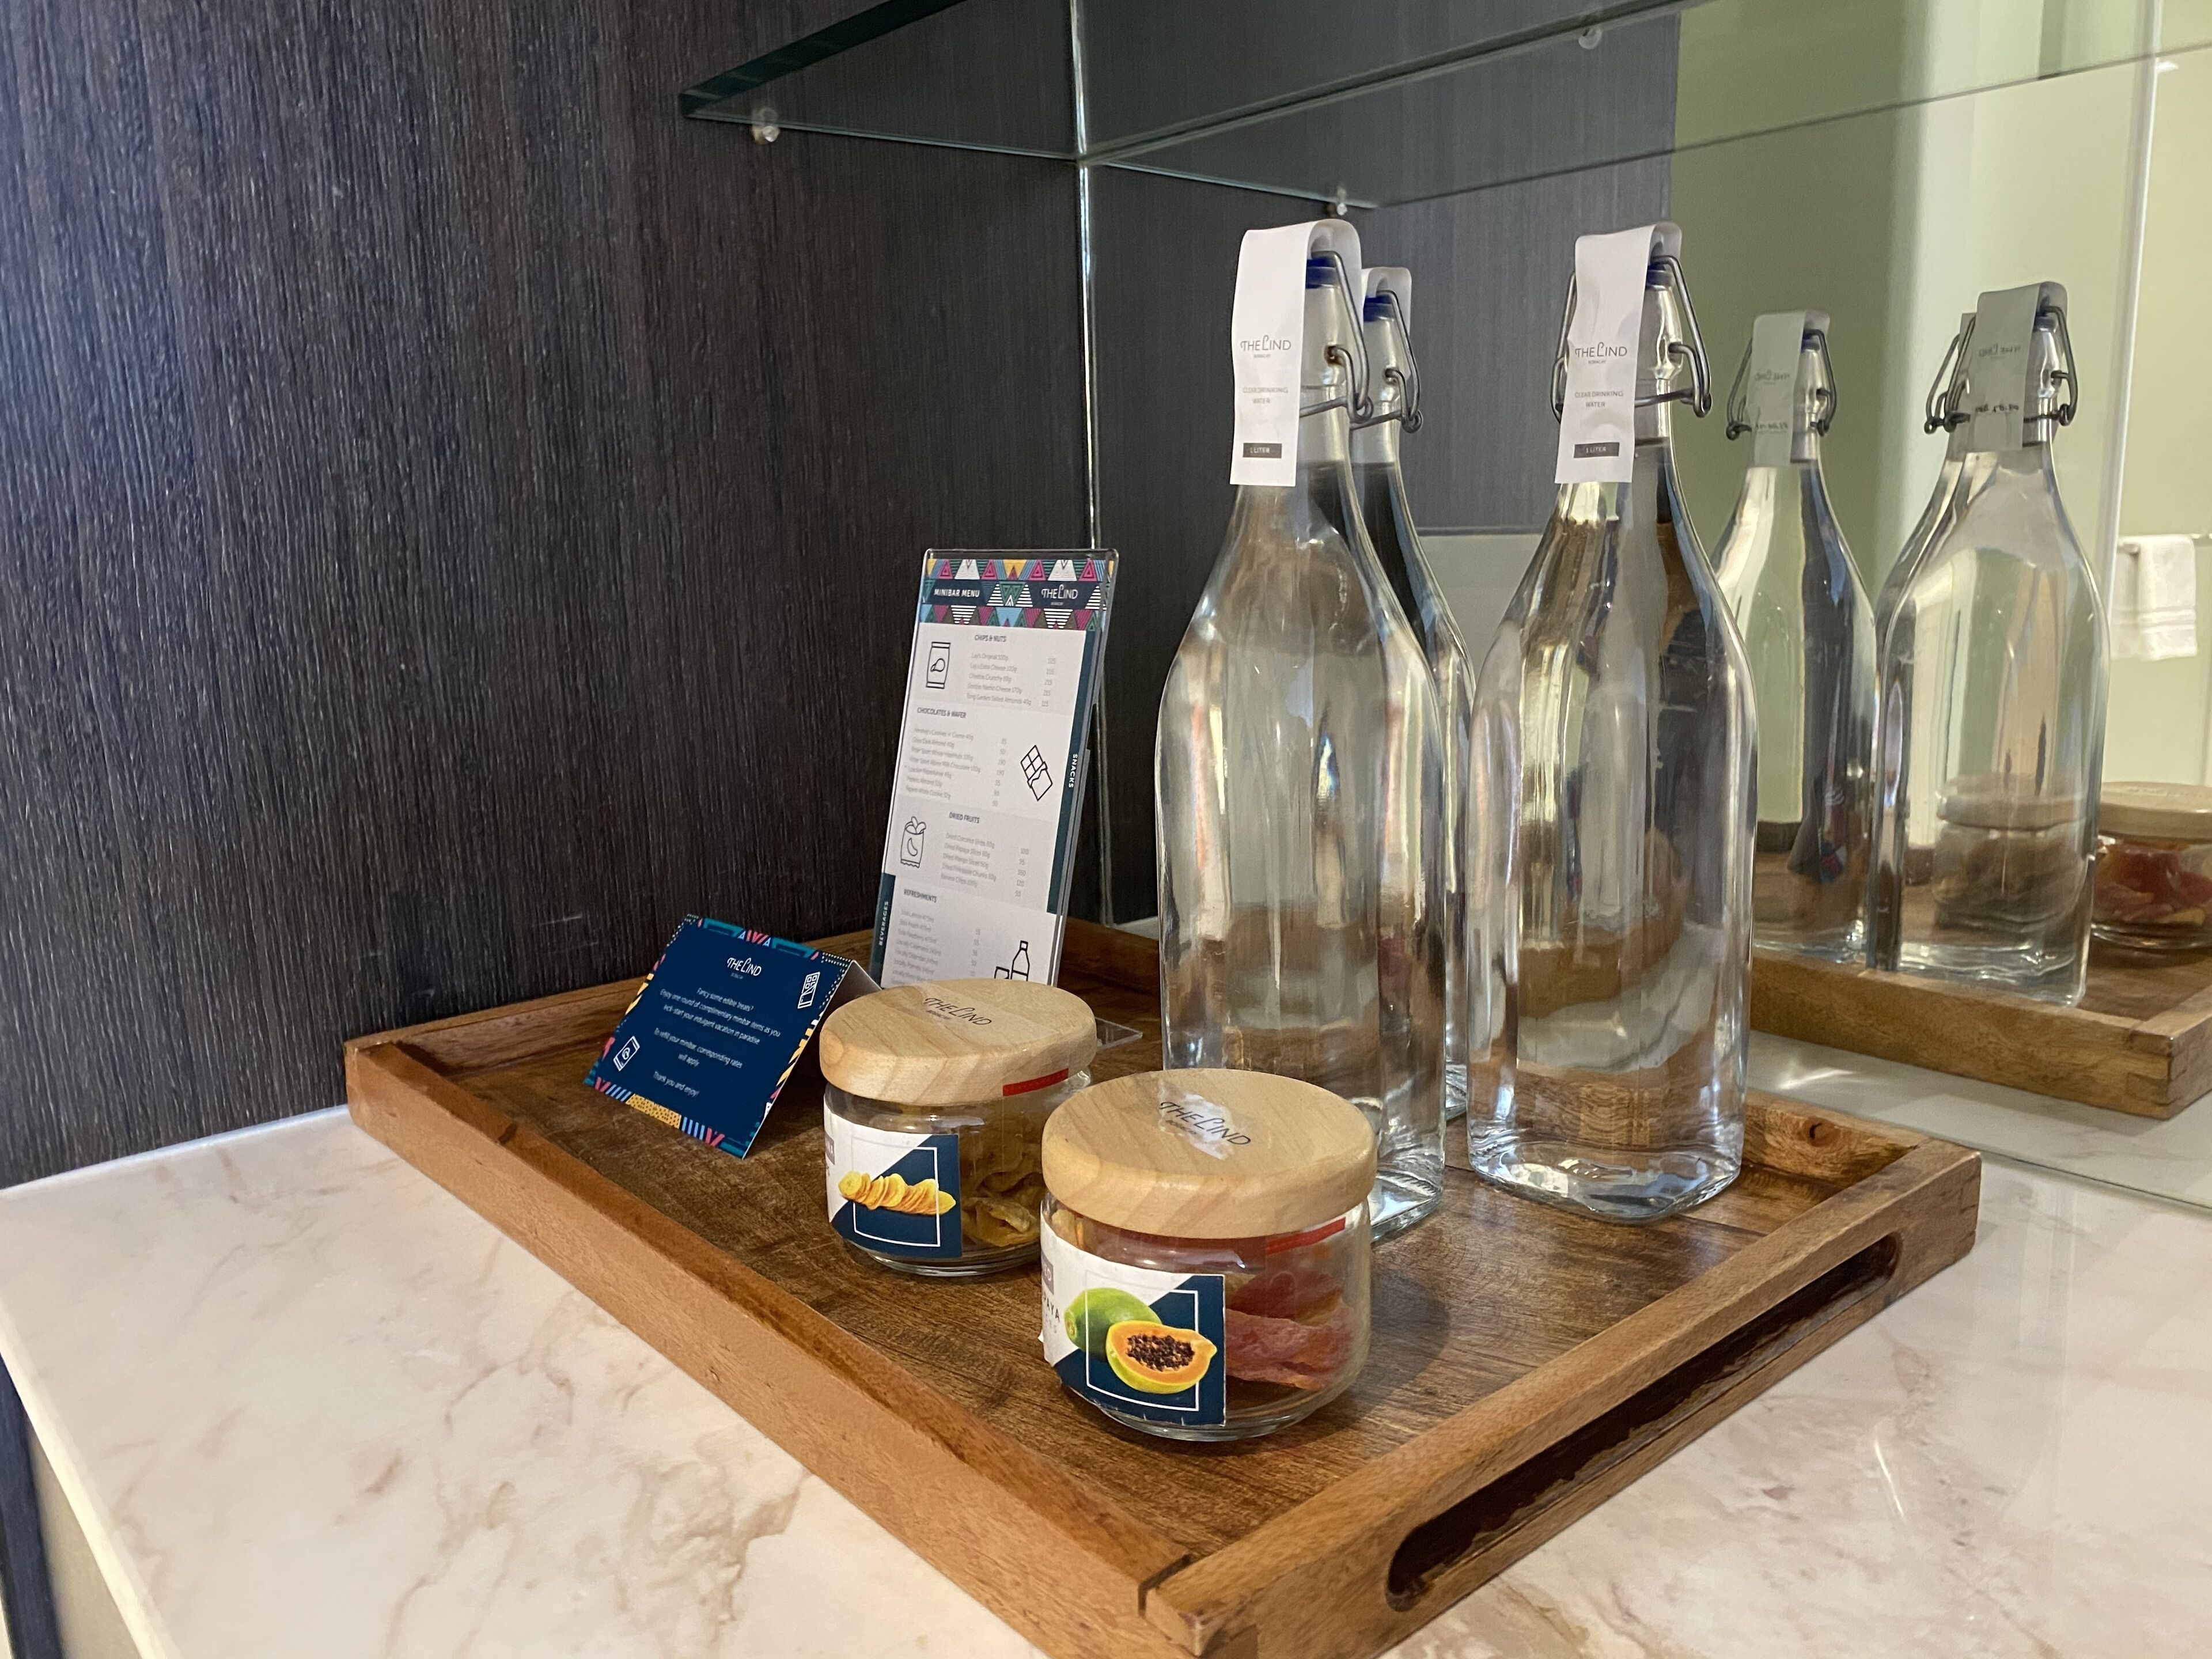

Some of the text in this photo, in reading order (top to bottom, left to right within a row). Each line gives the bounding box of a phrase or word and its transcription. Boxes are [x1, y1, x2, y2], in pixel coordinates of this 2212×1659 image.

[934, 588, 980, 597] MINIBAR MENU
[917, 707, 946, 716] CHOCOLATES
[1069, 753, 1078, 788] SNACKS
[949, 812, 980, 824] DRIED FRUITS
[904, 889, 937, 903] REFRESHMENTS
[879, 902, 888, 946] BEVERAGES
[696, 987, 710, 999] Fancy
[710, 993, 723, 1002] some
[737, 1002, 754, 1012] treats?
[660, 988, 672, 999] Enjoy
[680, 997, 695, 1006] round
[733, 1015, 751, 1026] minibar
[751, 1022, 764, 1032] items
[769, 1029, 781, 1038] you
[683, 1012, 694, 1020] your
[714, 1024, 735, 1036] vacation
[738, 1032, 760, 1045] paradise
[696, 1046, 730, 1066] corresponding
[730, 1059, 743, 1069] rates
[653, 1071, 666, 1082] Thank
[664, 1078, 676, 1086] you
[675, 1082, 685, 1090] and
